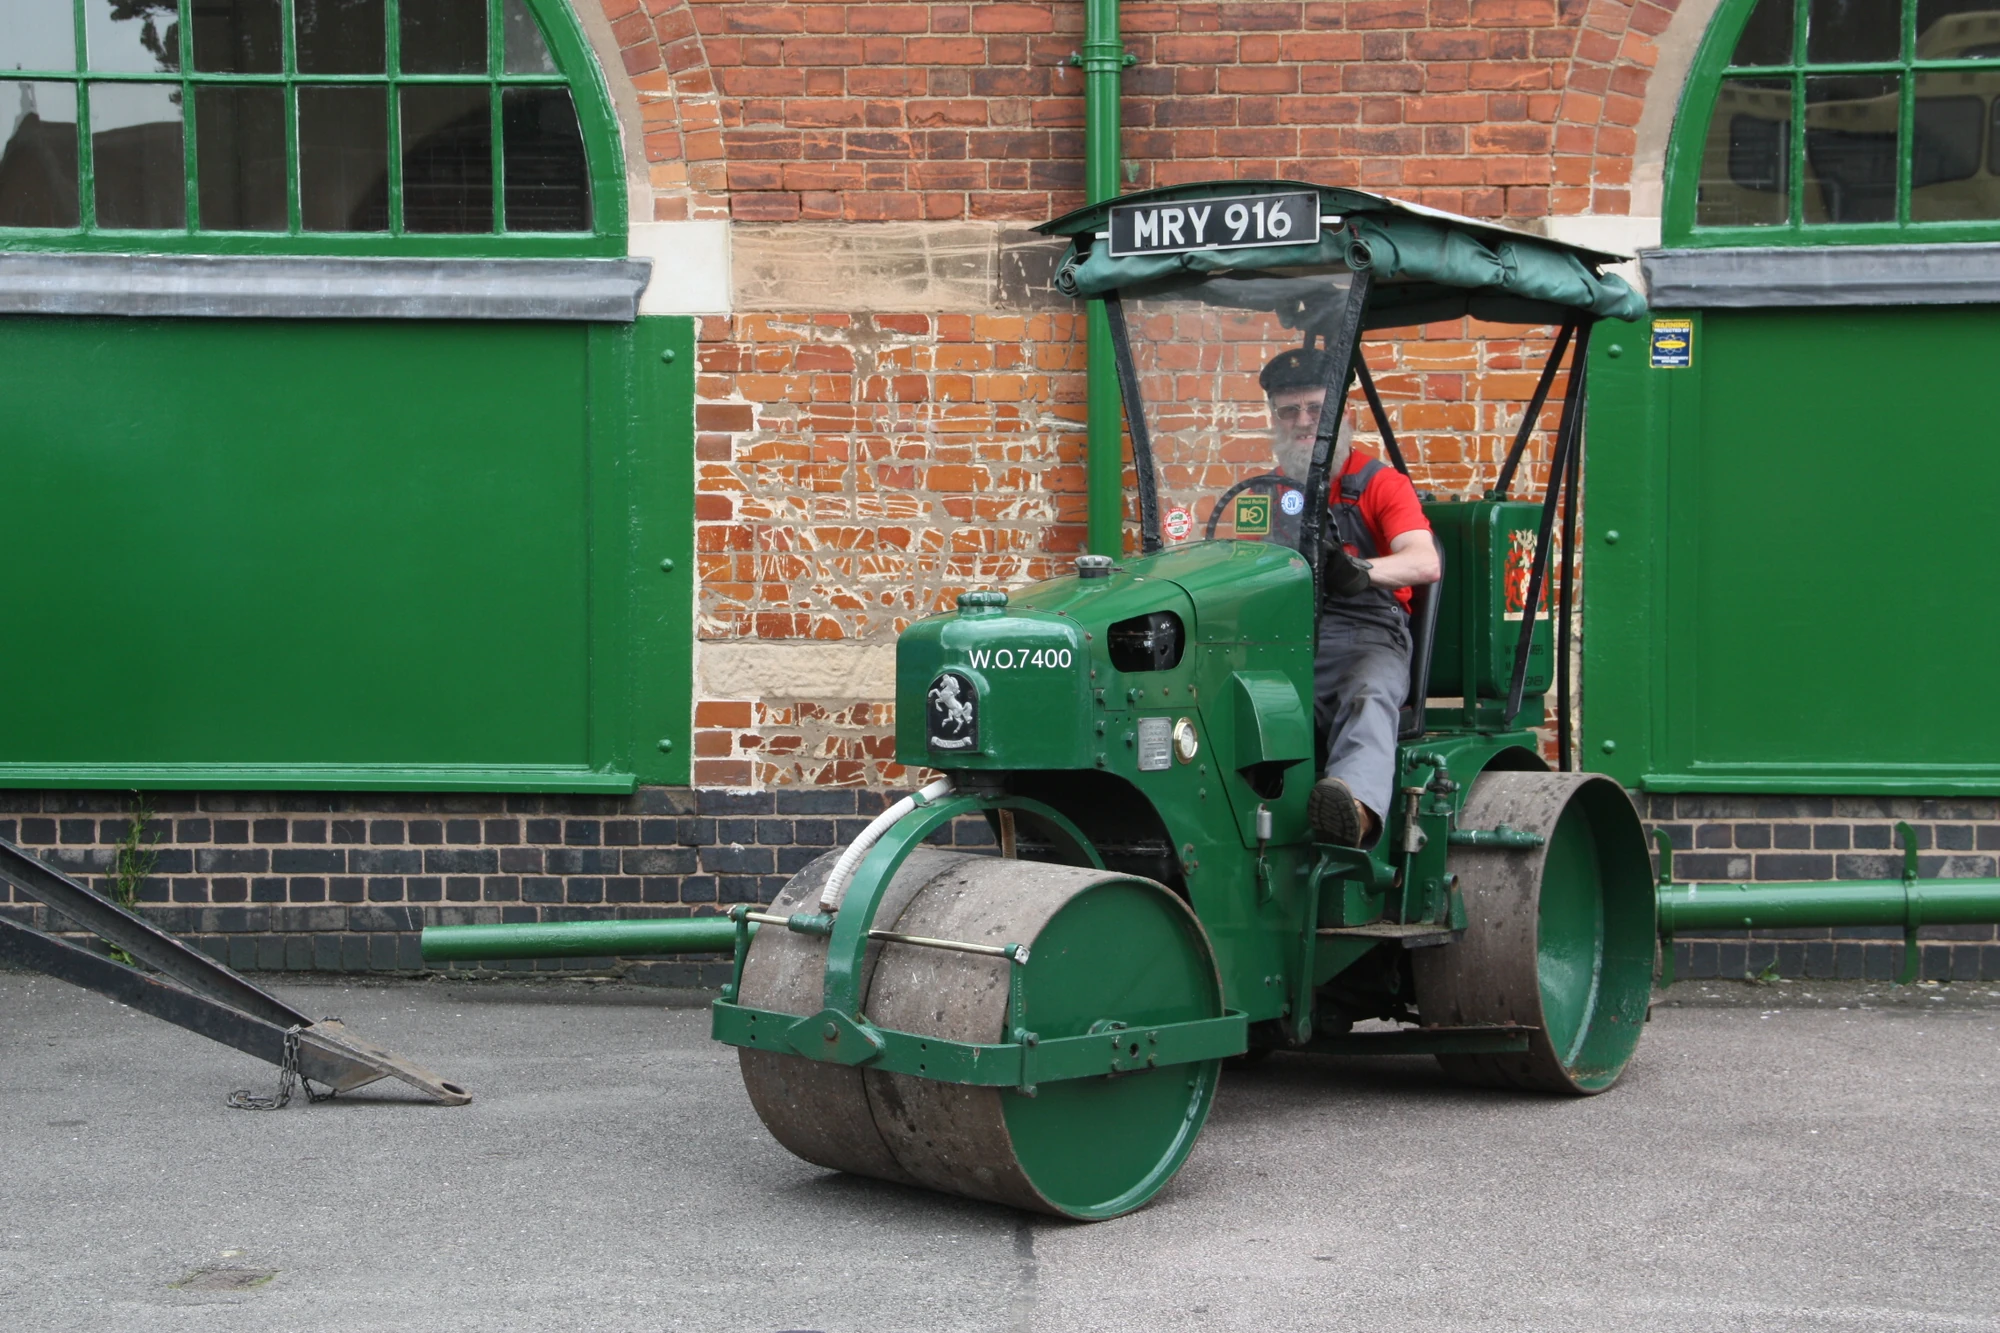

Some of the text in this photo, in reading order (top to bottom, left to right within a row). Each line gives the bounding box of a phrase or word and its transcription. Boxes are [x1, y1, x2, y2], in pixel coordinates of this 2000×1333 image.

[1134, 200, 1292, 248] MRY 916
[1287, 496, 1297, 508] SV
[969, 649, 1072, 669] W.O.7400
